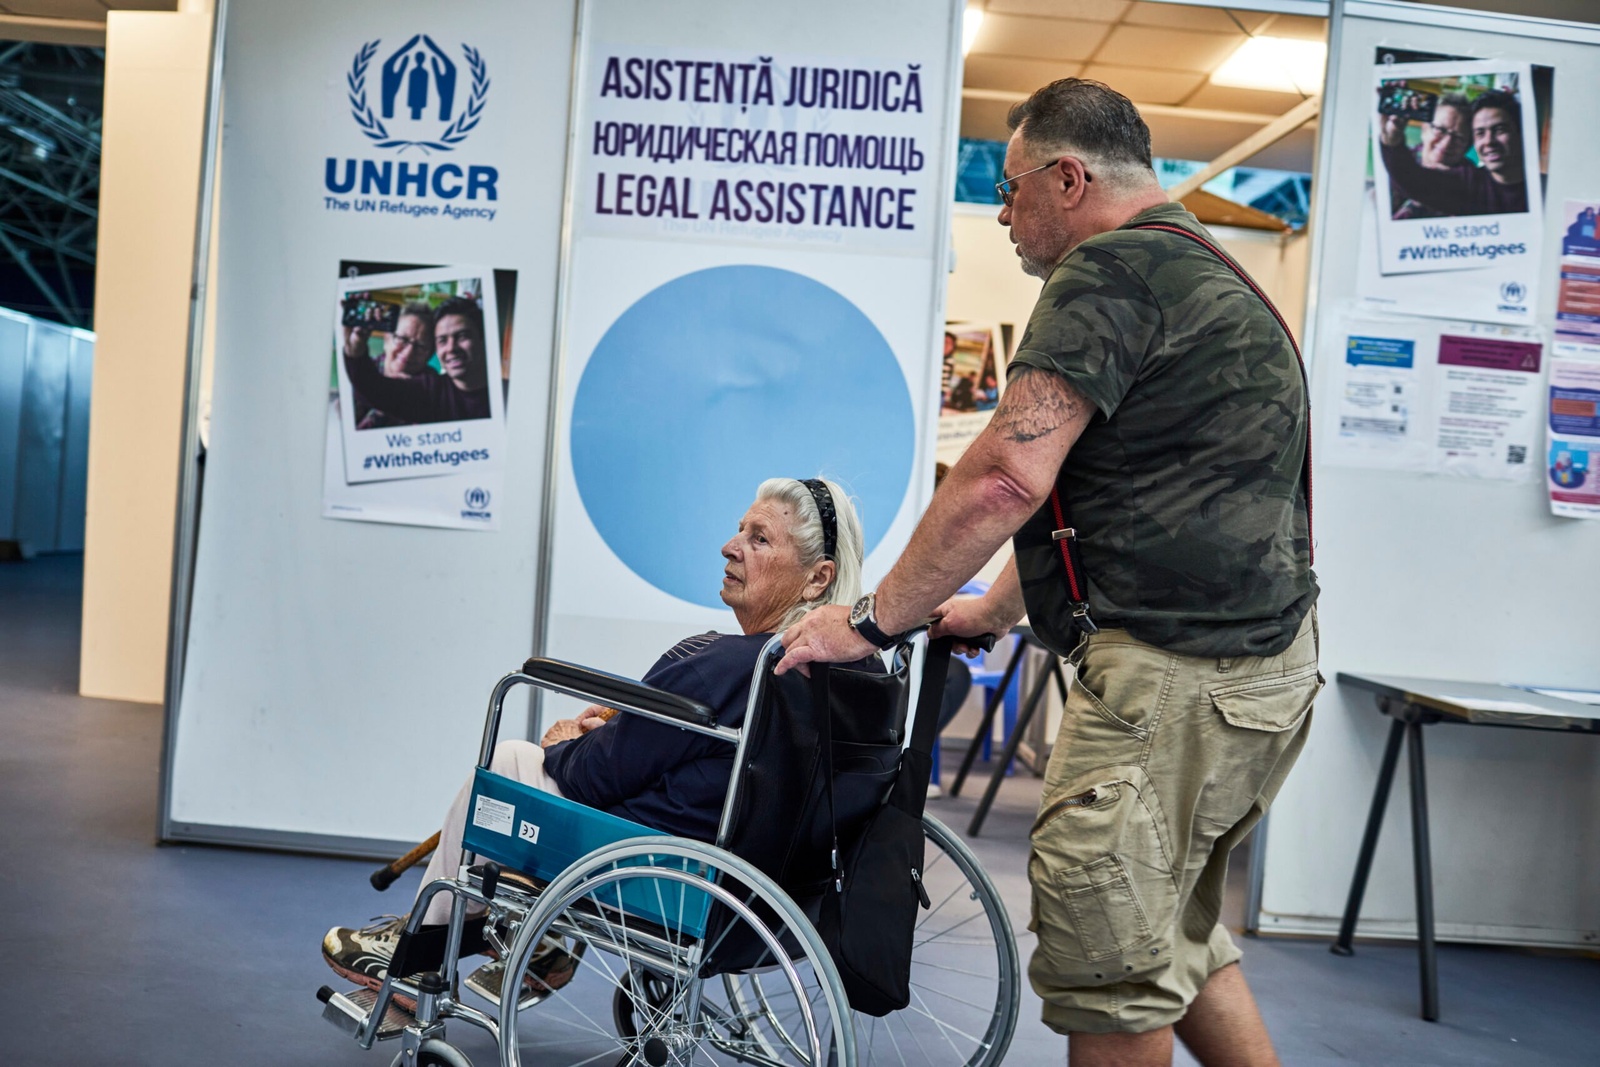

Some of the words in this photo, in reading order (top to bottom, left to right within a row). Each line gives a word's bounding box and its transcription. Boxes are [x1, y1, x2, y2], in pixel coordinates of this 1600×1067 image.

[600, 56, 775, 114] ASISTENȚĂ
[783, 64, 924, 113] JURIDICĂ
[593, 121, 798, 165] ЮРИДИЧЕСКАЯ
[804, 132, 925, 175] ПОМОЩЬ
[324, 157, 499, 201] UNHCR
[324, 197, 351, 211] The
[354, 199, 376, 213] UN
[379, 200, 439, 217] Refugee
[442, 203, 496, 220] Agency
[595, 172, 699, 219] LEGAL
[709, 179, 917, 230] ASSISTANCE
[1422, 225, 1449, 239] We
[1454, 222, 1500, 238] stand
[1398, 241, 1527, 260] #WithRefugees
[385, 434, 412, 448] We
[417, 428, 462, 446] stand
[363, 449, 489, 469] #WithRefugees
